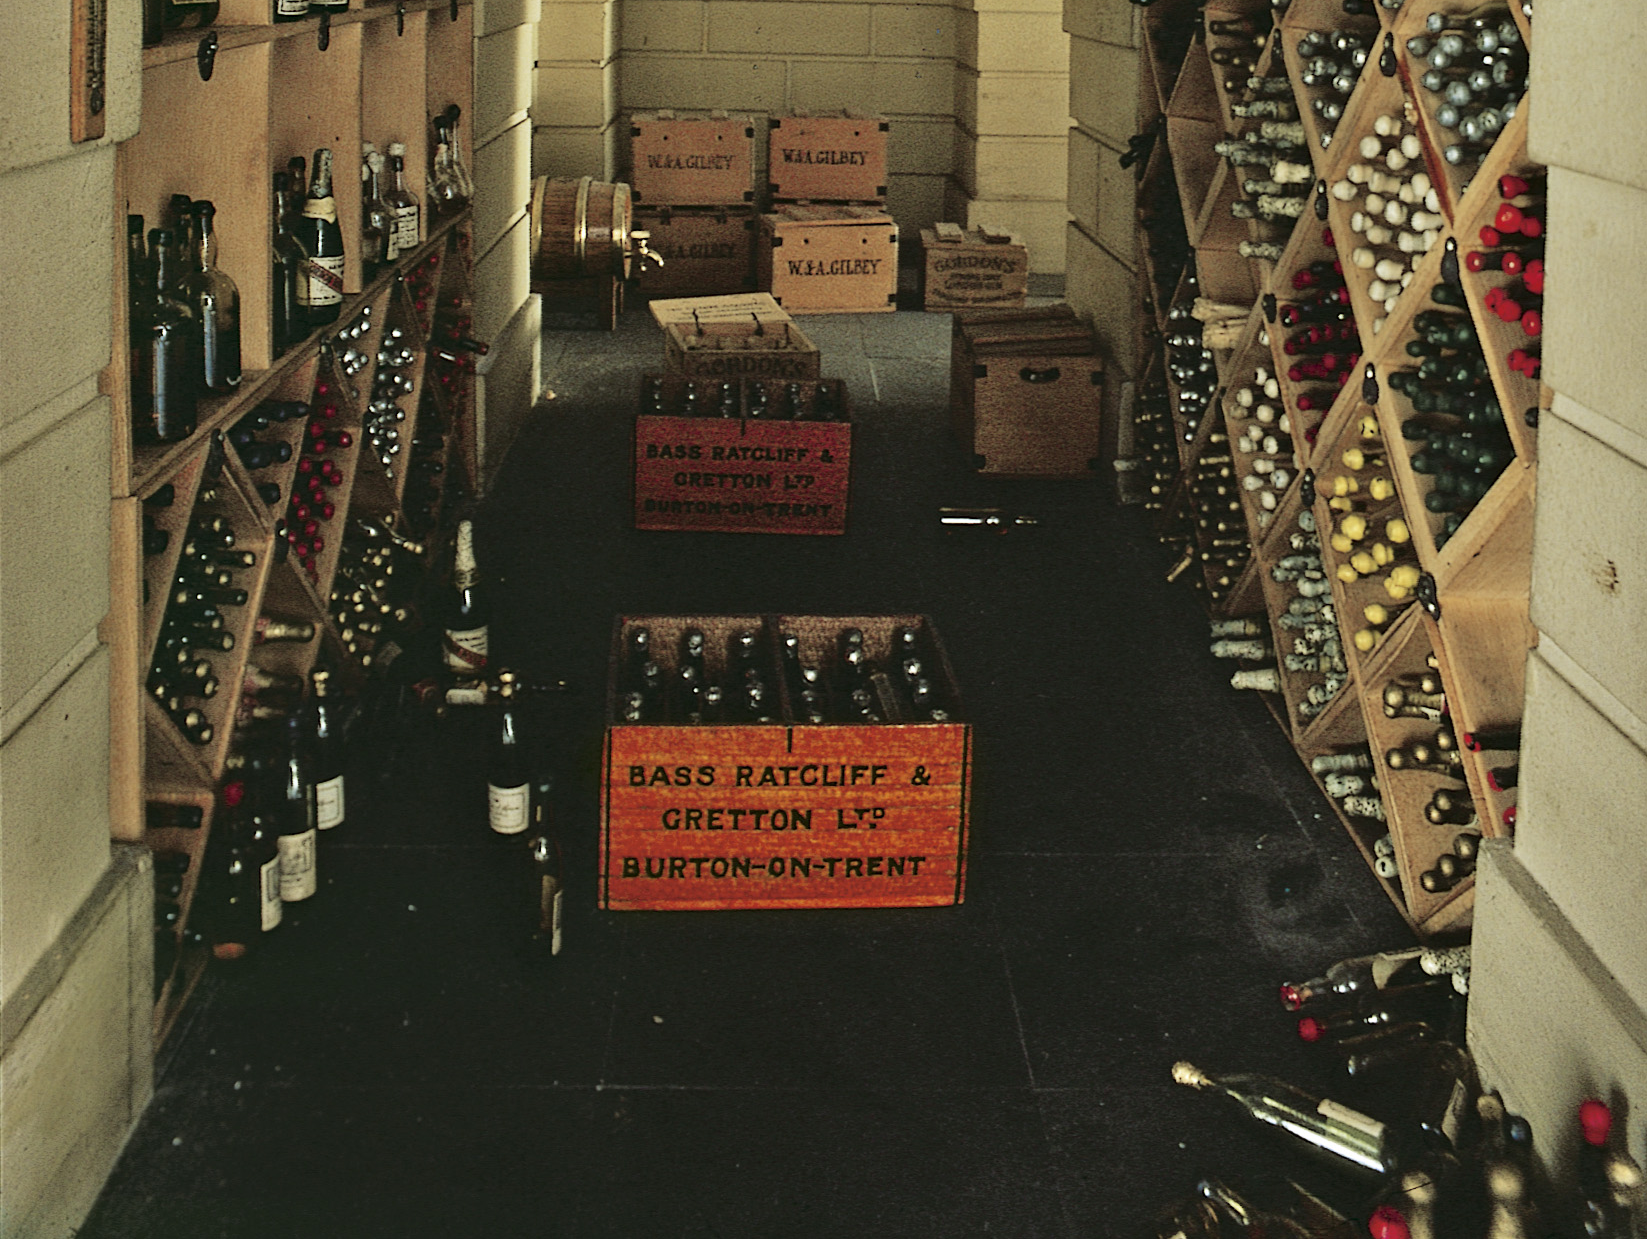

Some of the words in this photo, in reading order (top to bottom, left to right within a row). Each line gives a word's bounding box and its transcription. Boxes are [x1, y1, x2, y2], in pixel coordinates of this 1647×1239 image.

[646, 444, 701, 460] BASS
[711, 445, 809, 462] RATCLIFF
[820, 448, 834, 463] &
[673, 471, 771, 489] GRETTON
[628, 765, 716, 787] BASS
[736, 765, 888, 787] RATCLIFF
[910, 765, 931, 786] &
[661, 808, 812, 831] GRETTON
[622, 856, 926, 879] BURTON-ON-TRENT
